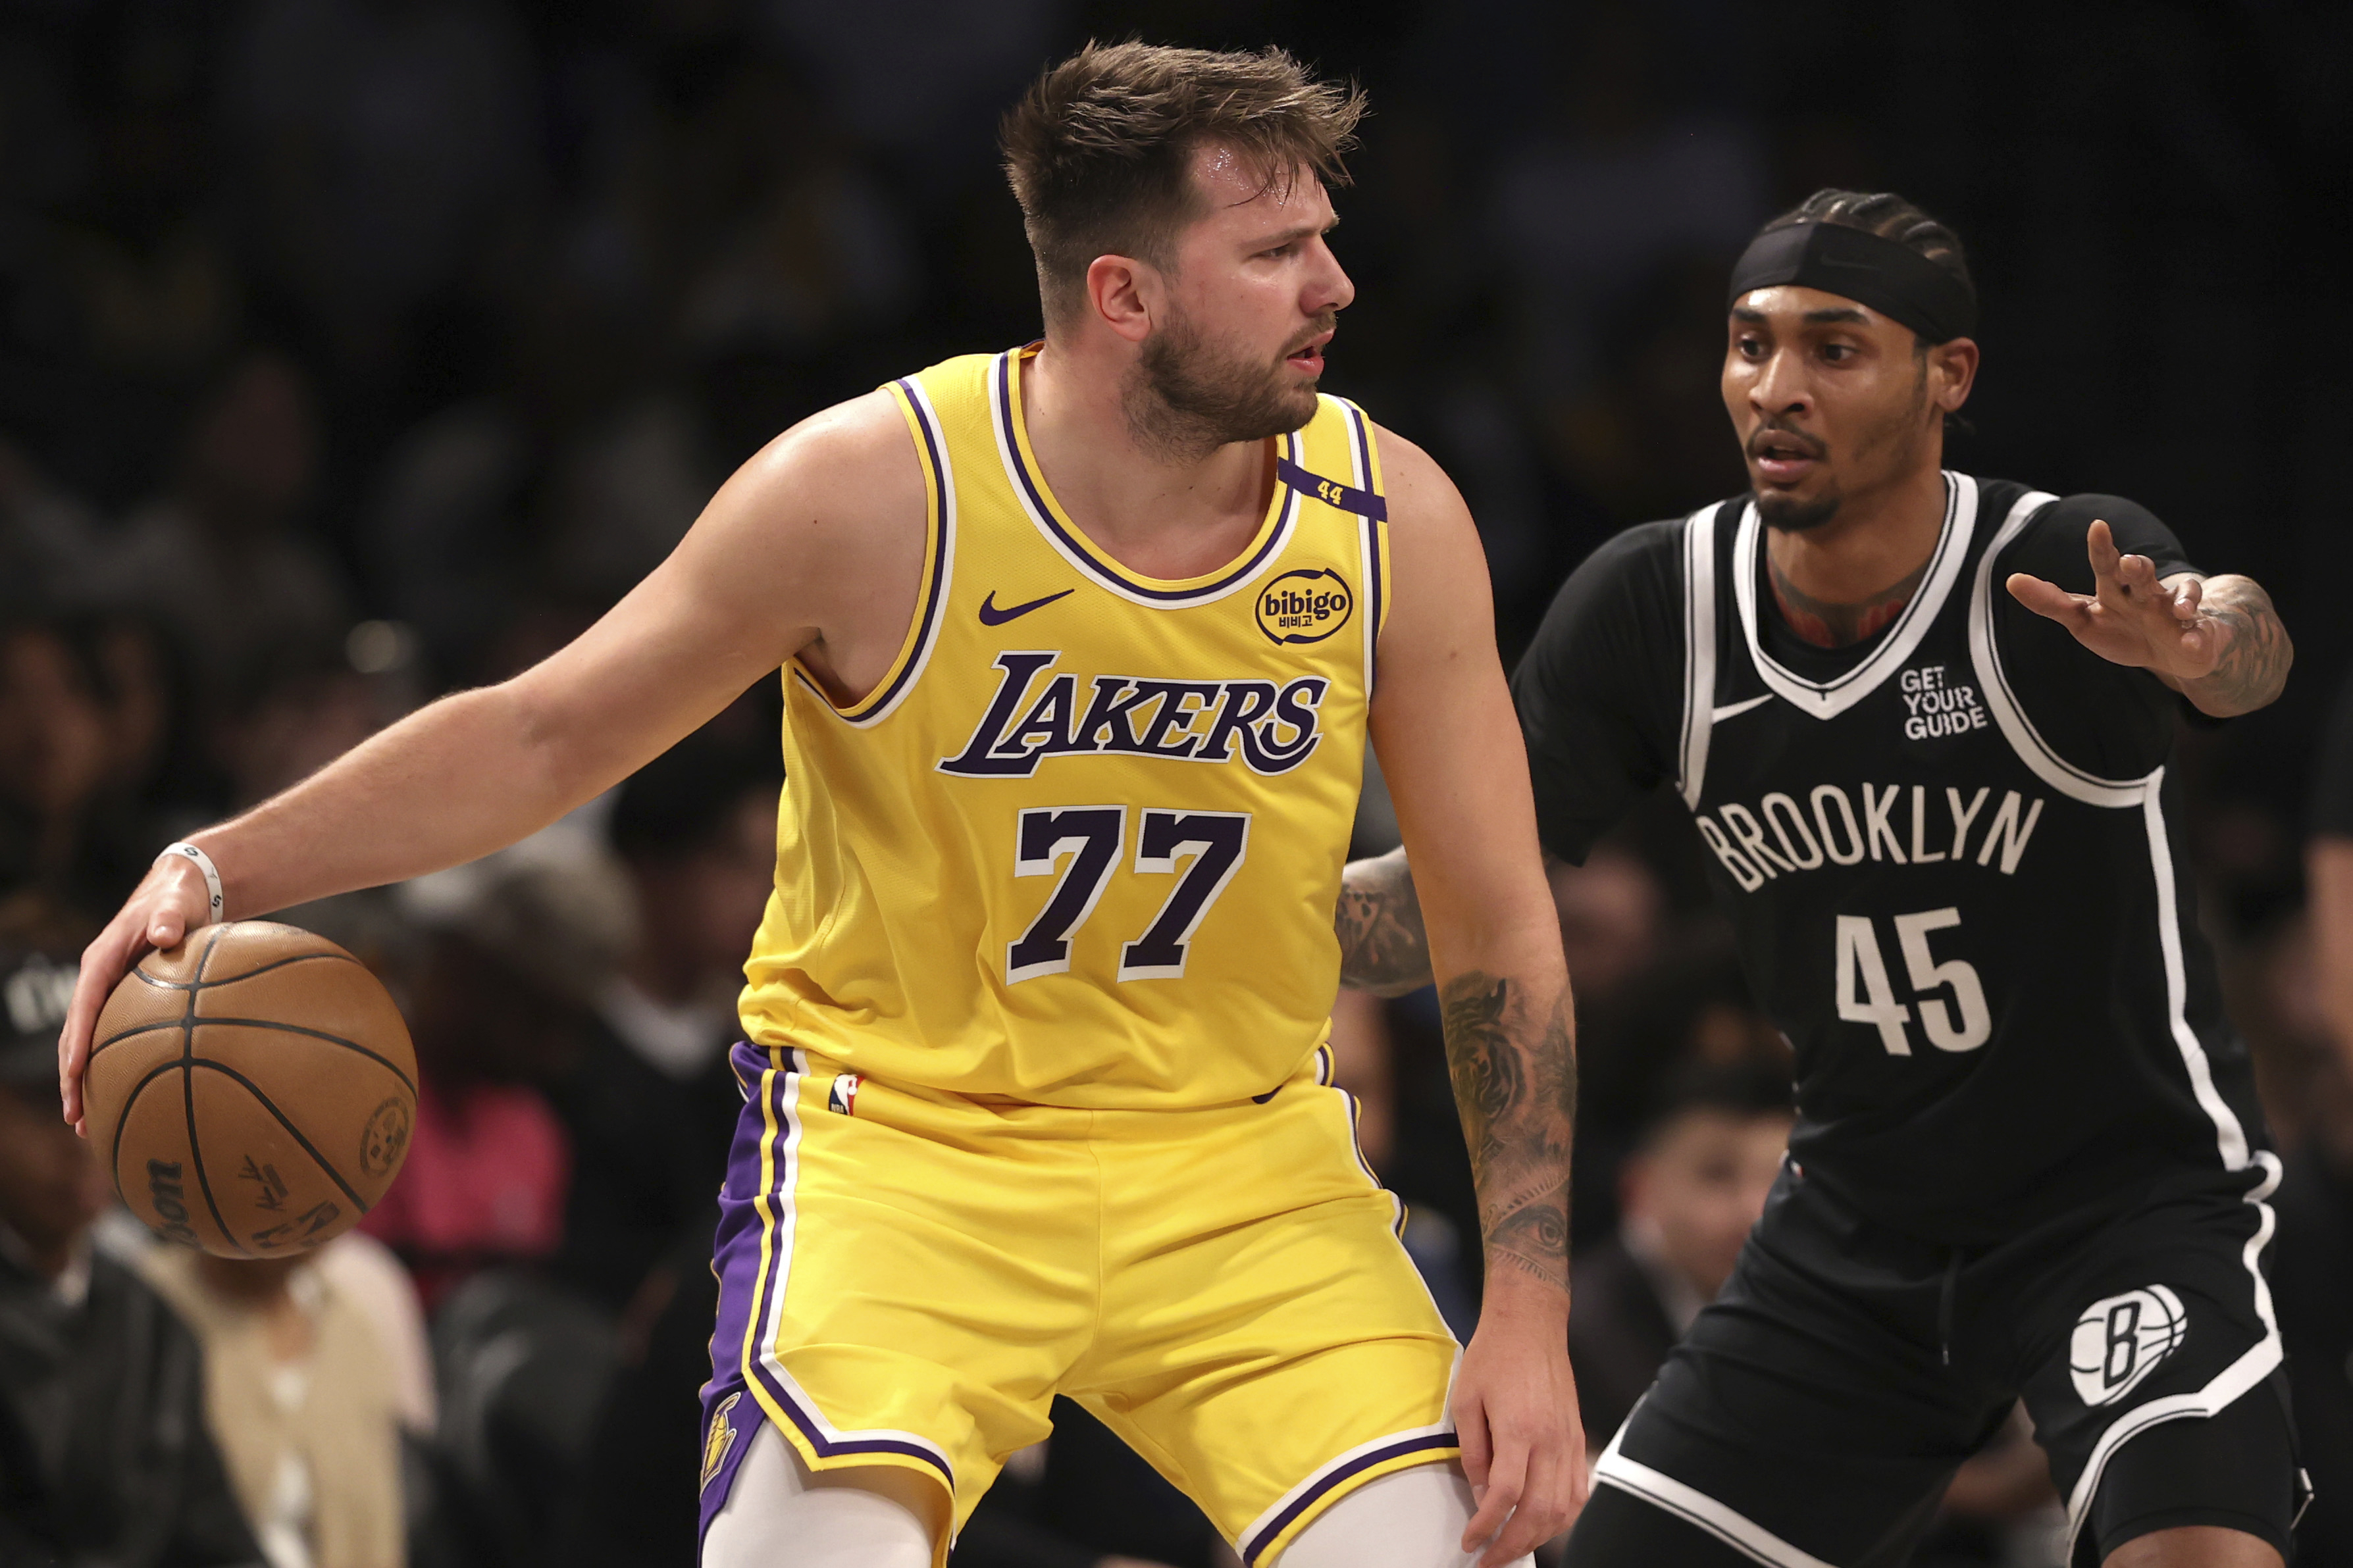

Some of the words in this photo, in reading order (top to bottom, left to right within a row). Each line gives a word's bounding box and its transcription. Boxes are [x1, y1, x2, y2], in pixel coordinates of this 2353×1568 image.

[1318, 480, 1344, 505] 44
[1265, 589, 1347, 620] bibigo
[1279, 615, 1313, 629] 비비고
[1900, 666, 1944, 693] GET
[935, 650, 1332, 778] LAKERS
[1902, 686, 1977, 716] YOUR
[1904, 706, 1988, 741] GUIDE
[1695, 782, 2044, 894] BROOKLYN
[1006, 804, 1253, 986] 77
[1835, 906, 1992, 1056] 45
[831, 1103, 844, 1113] NBA
[2104, 1300, 2142, 1390] B
